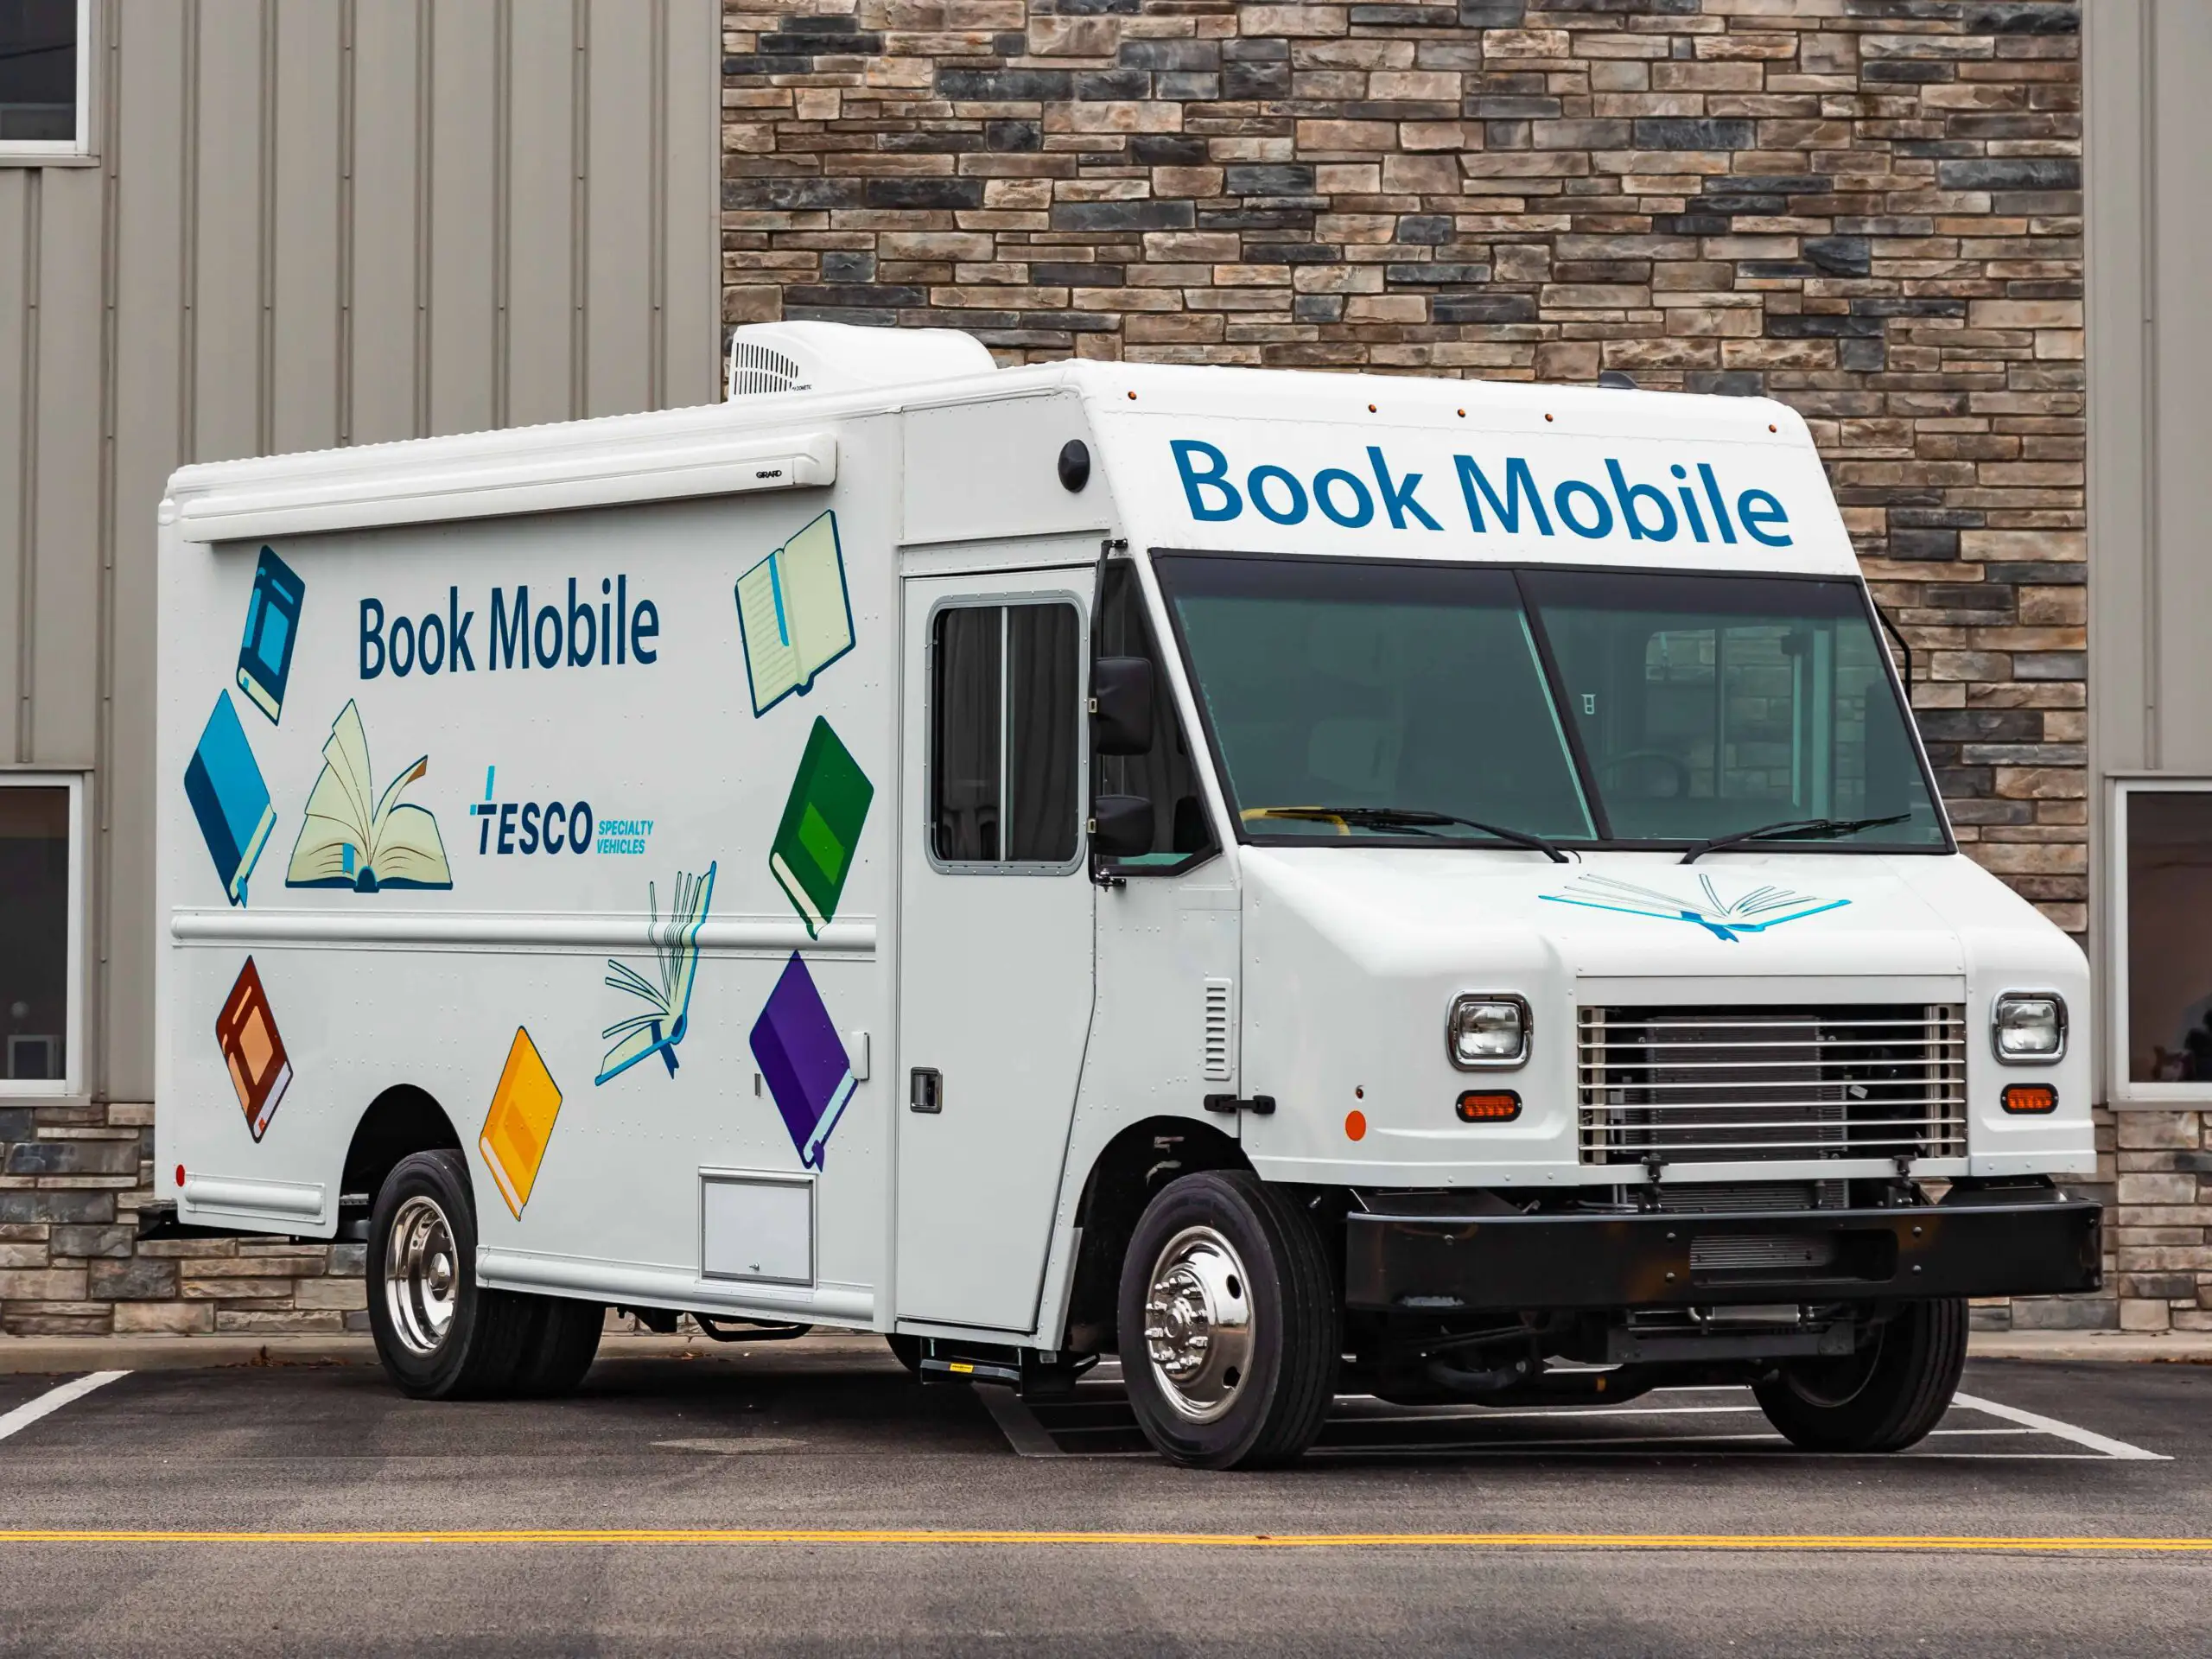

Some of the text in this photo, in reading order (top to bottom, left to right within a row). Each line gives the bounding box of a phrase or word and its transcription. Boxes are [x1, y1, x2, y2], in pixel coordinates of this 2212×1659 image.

[1169, 439, 1793, 548] Book Mobile
[359, 574, 660, 680] Book Mobile
[470, 801, 594, 855] TESCO
[596, 839, 646, 854] VEHICLES
[598, 821, 654, 836] SPECIALTY
